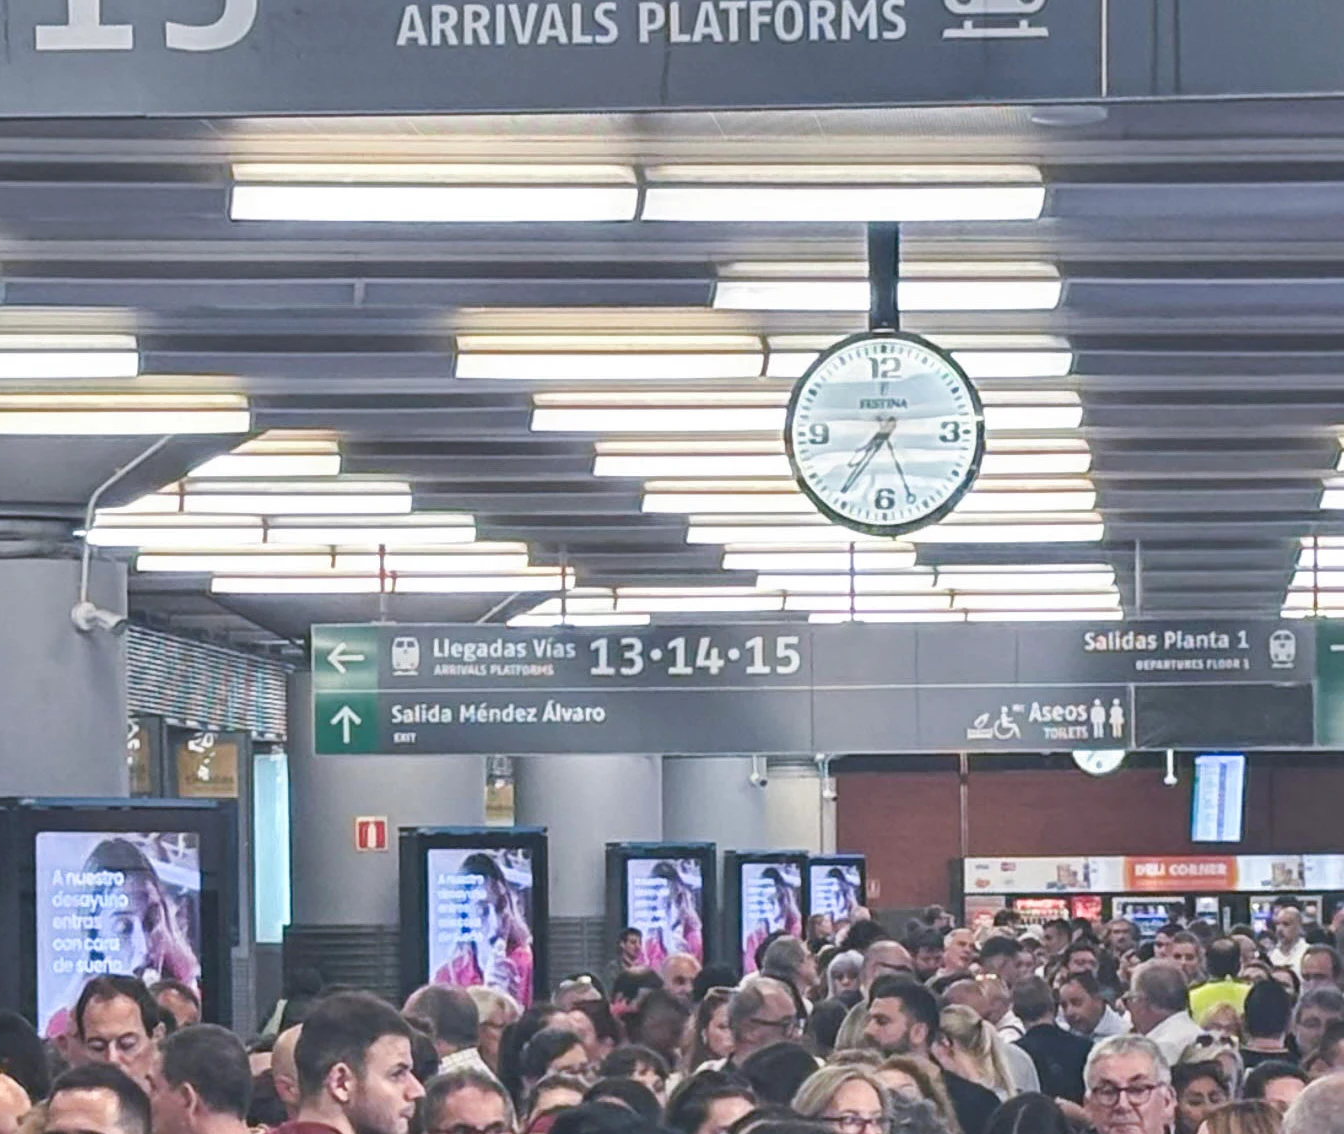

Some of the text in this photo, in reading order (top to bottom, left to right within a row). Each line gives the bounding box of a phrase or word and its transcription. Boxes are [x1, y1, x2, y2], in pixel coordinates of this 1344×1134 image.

[396, 0, 907, 47] ARRIVALS PLATFORMS
[868, 356, 902, 379] 12
[859, 398, 908, 410] FESTINA
[808, 423, 829, 445] 9
[939, 421, 960, 443] 3
[874, 488, 895, 510] 6
[433, 637, 527, 662] Llegadas
[532, 636, 577, 659] Vías
[1083, 630, 1250, 650] Salidas Planta 1
[434, 664, 554, 676] ARRIVALS PLATFORMS
[1135, 659, 1204, 671] DEPARTURES
[1207, 658, 1241, 670] FLOOR
[391, 700, 606, 723] Salida Méndez Álvaro
[1028, 702, 1088, 722] Aseos
[393, 732, 417, 743] EXIT
[1043, 726, 1088, 739] TOILETS
[1134, 862, 1228, 876] DELI CORNER
